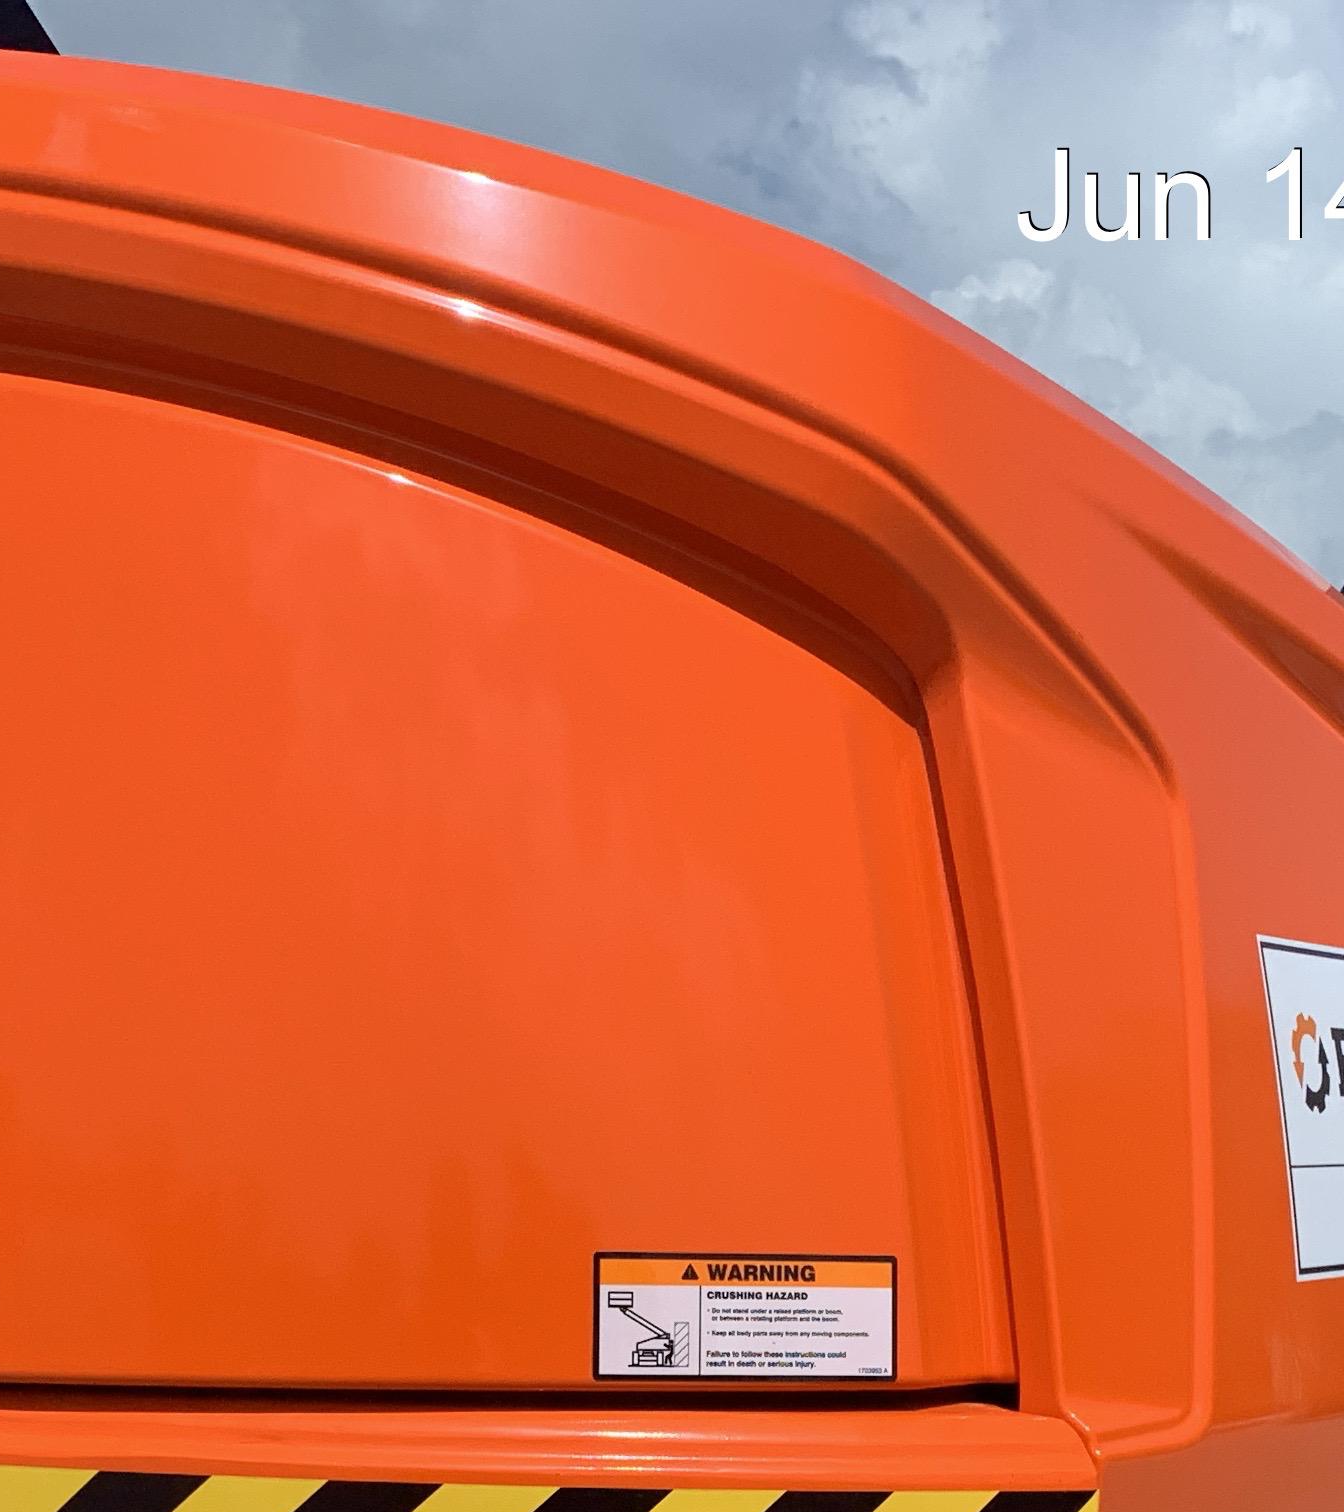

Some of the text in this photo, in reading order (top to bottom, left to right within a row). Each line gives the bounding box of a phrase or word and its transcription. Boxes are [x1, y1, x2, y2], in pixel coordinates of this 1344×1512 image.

[707, 1263, 816, 1282] WARNING
[706, 1291, 808, 1300] CRUSHING HAZARD
[706, 1350, 731, 1358] Failure
[732, 1350, 739, 1358] to
[741, 1350, 763, 1358] follow
[784, 1351, 826, 1359] instructions
[827, 1351, 847, 1359] could
[705, 1360, 727, 1368] result
[727, 1360, 735, 1368] in
[736, 1360, 757, 1368] death
[767, 1360, 794, 1368] serious
[794, 1360, 817, 1369] injury.
